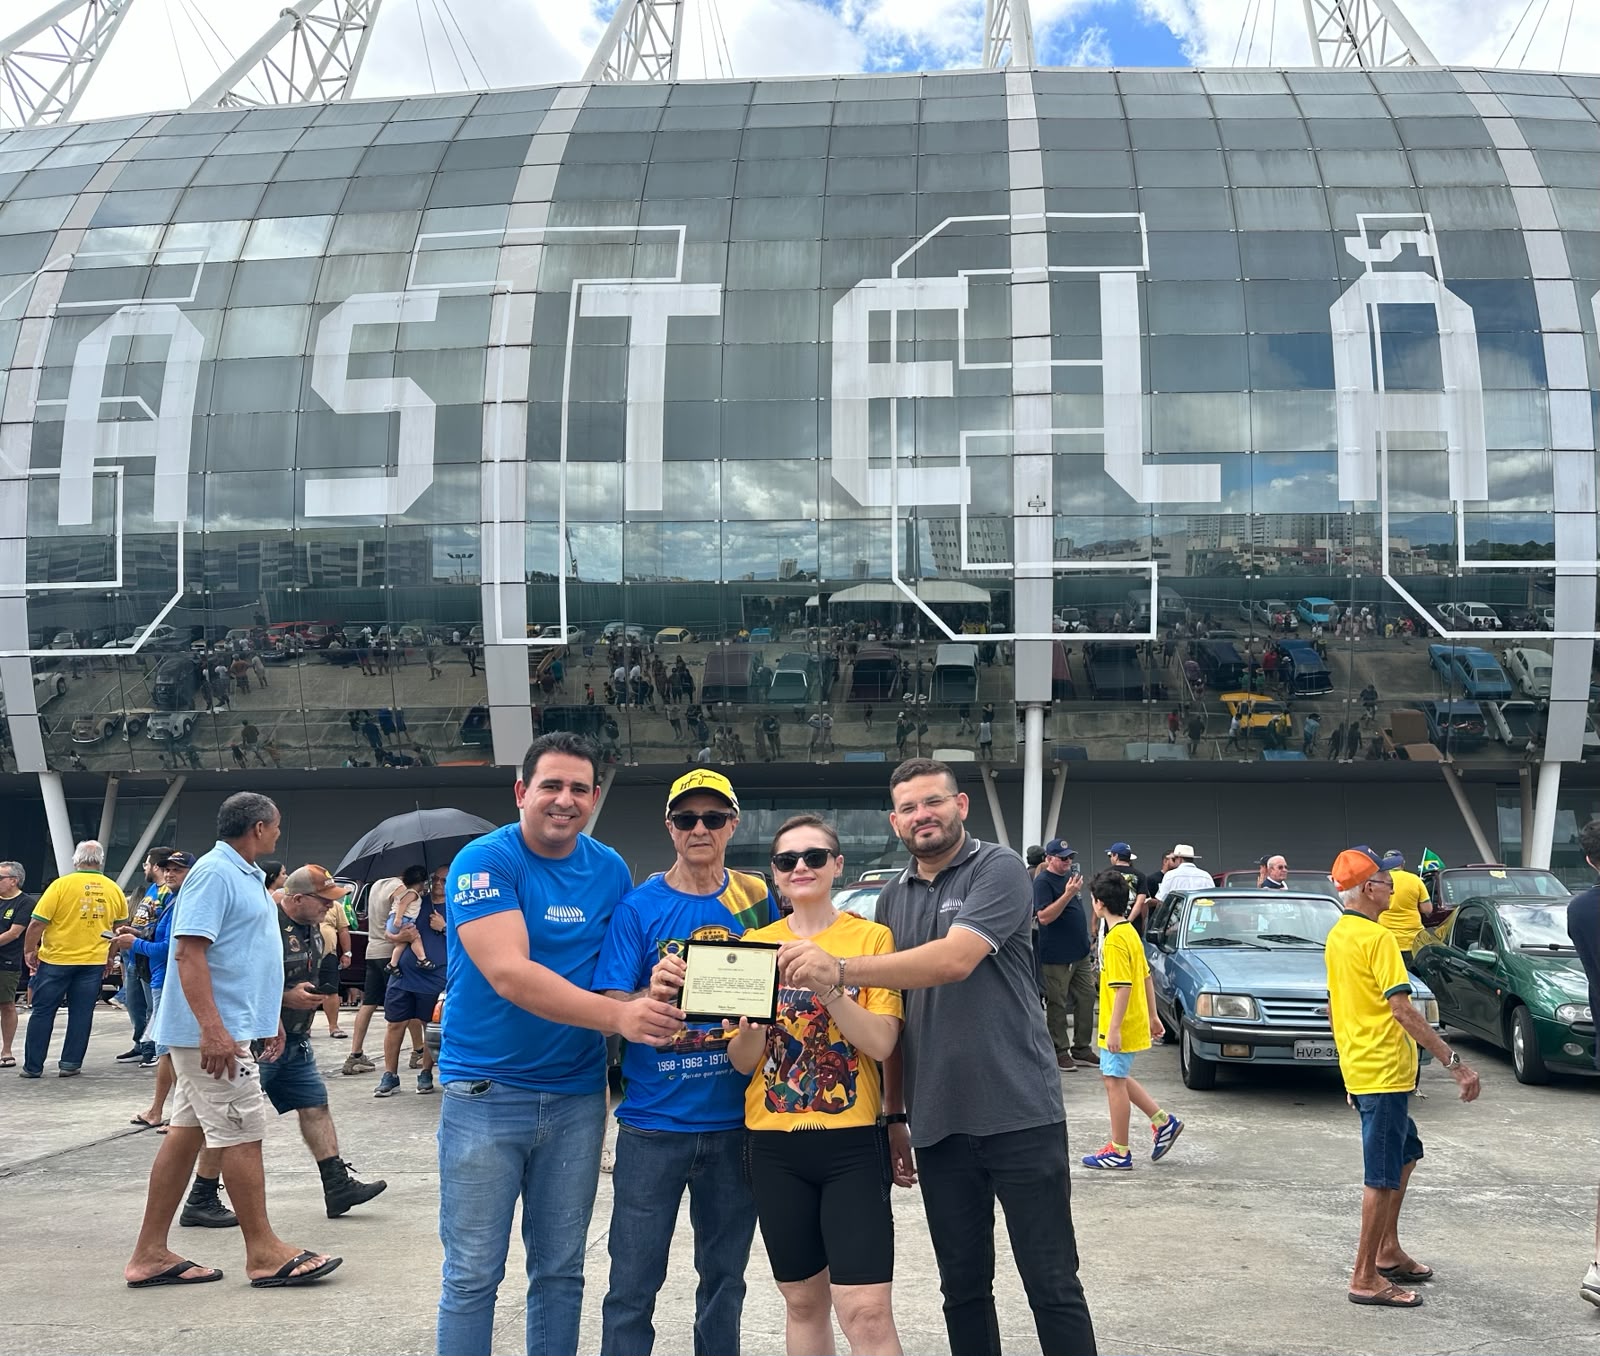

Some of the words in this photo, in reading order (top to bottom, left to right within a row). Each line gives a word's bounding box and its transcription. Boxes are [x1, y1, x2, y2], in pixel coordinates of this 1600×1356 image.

[58, 229, 1600, 525] ASTELÃ
[478, 888, 500, 900] EUA
[1296, 1047, 1321, 1058] HVP
[657, 1060, 676, 1072] 1958
[682, 1056, 703, 1069] 1962
[709, 1053, 729, 1065] 1970
